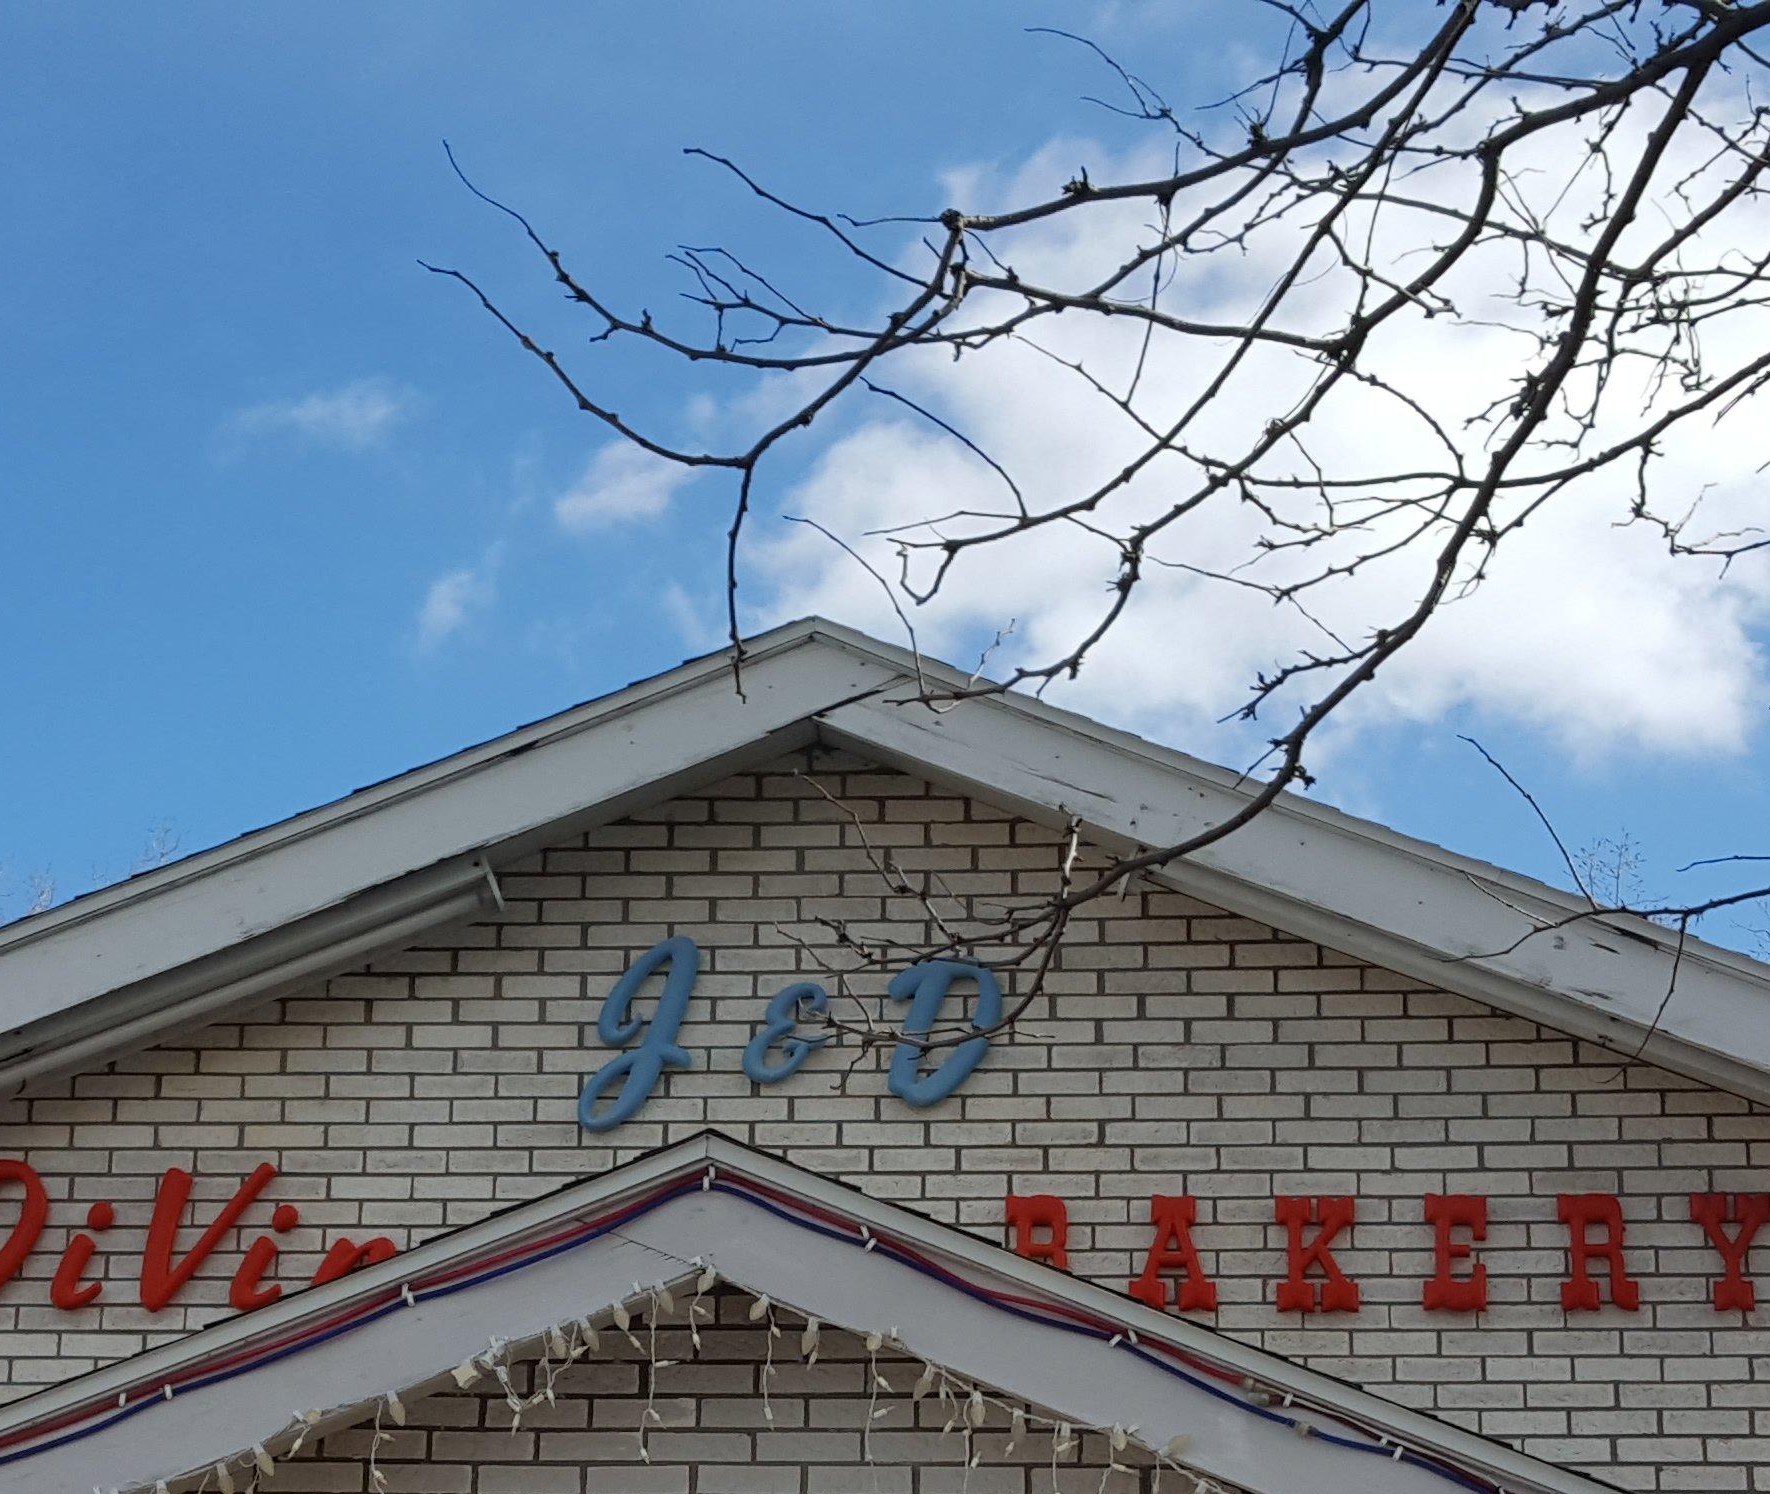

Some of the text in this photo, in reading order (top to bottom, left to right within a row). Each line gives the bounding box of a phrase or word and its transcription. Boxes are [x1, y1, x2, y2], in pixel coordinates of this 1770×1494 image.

[578, 935, 1004, 1132] J & D
